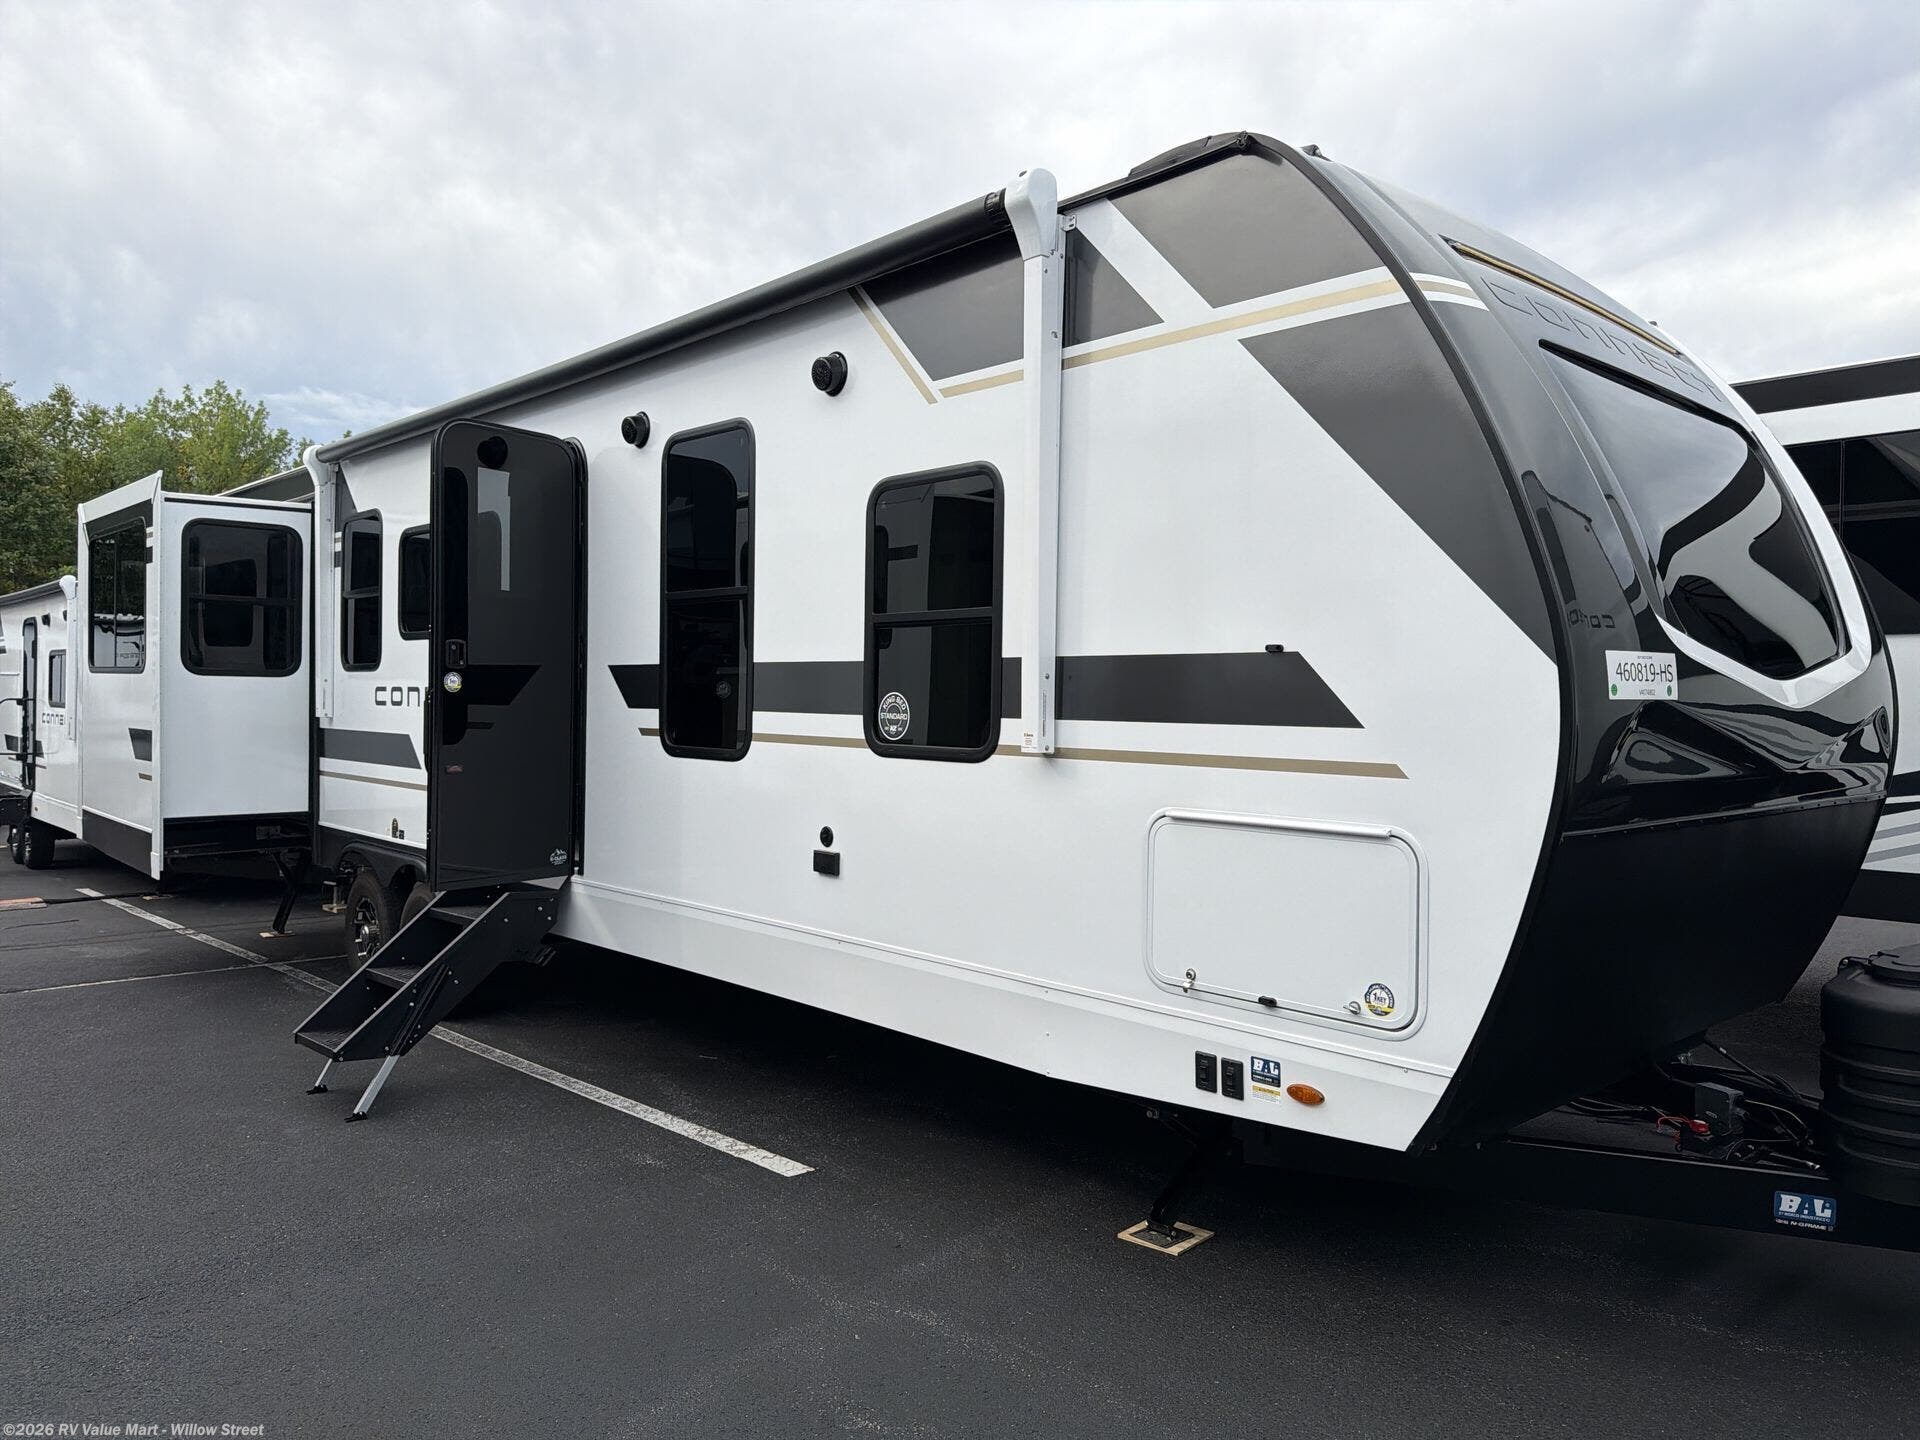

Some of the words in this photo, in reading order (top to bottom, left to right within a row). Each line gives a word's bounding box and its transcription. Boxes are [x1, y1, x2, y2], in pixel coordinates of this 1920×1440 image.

[1615, 662, 1674, 683] 460819-HS
[880, 712, 908, 720] STANDARD
[1779, 1194, 1832, 1218] BAL
